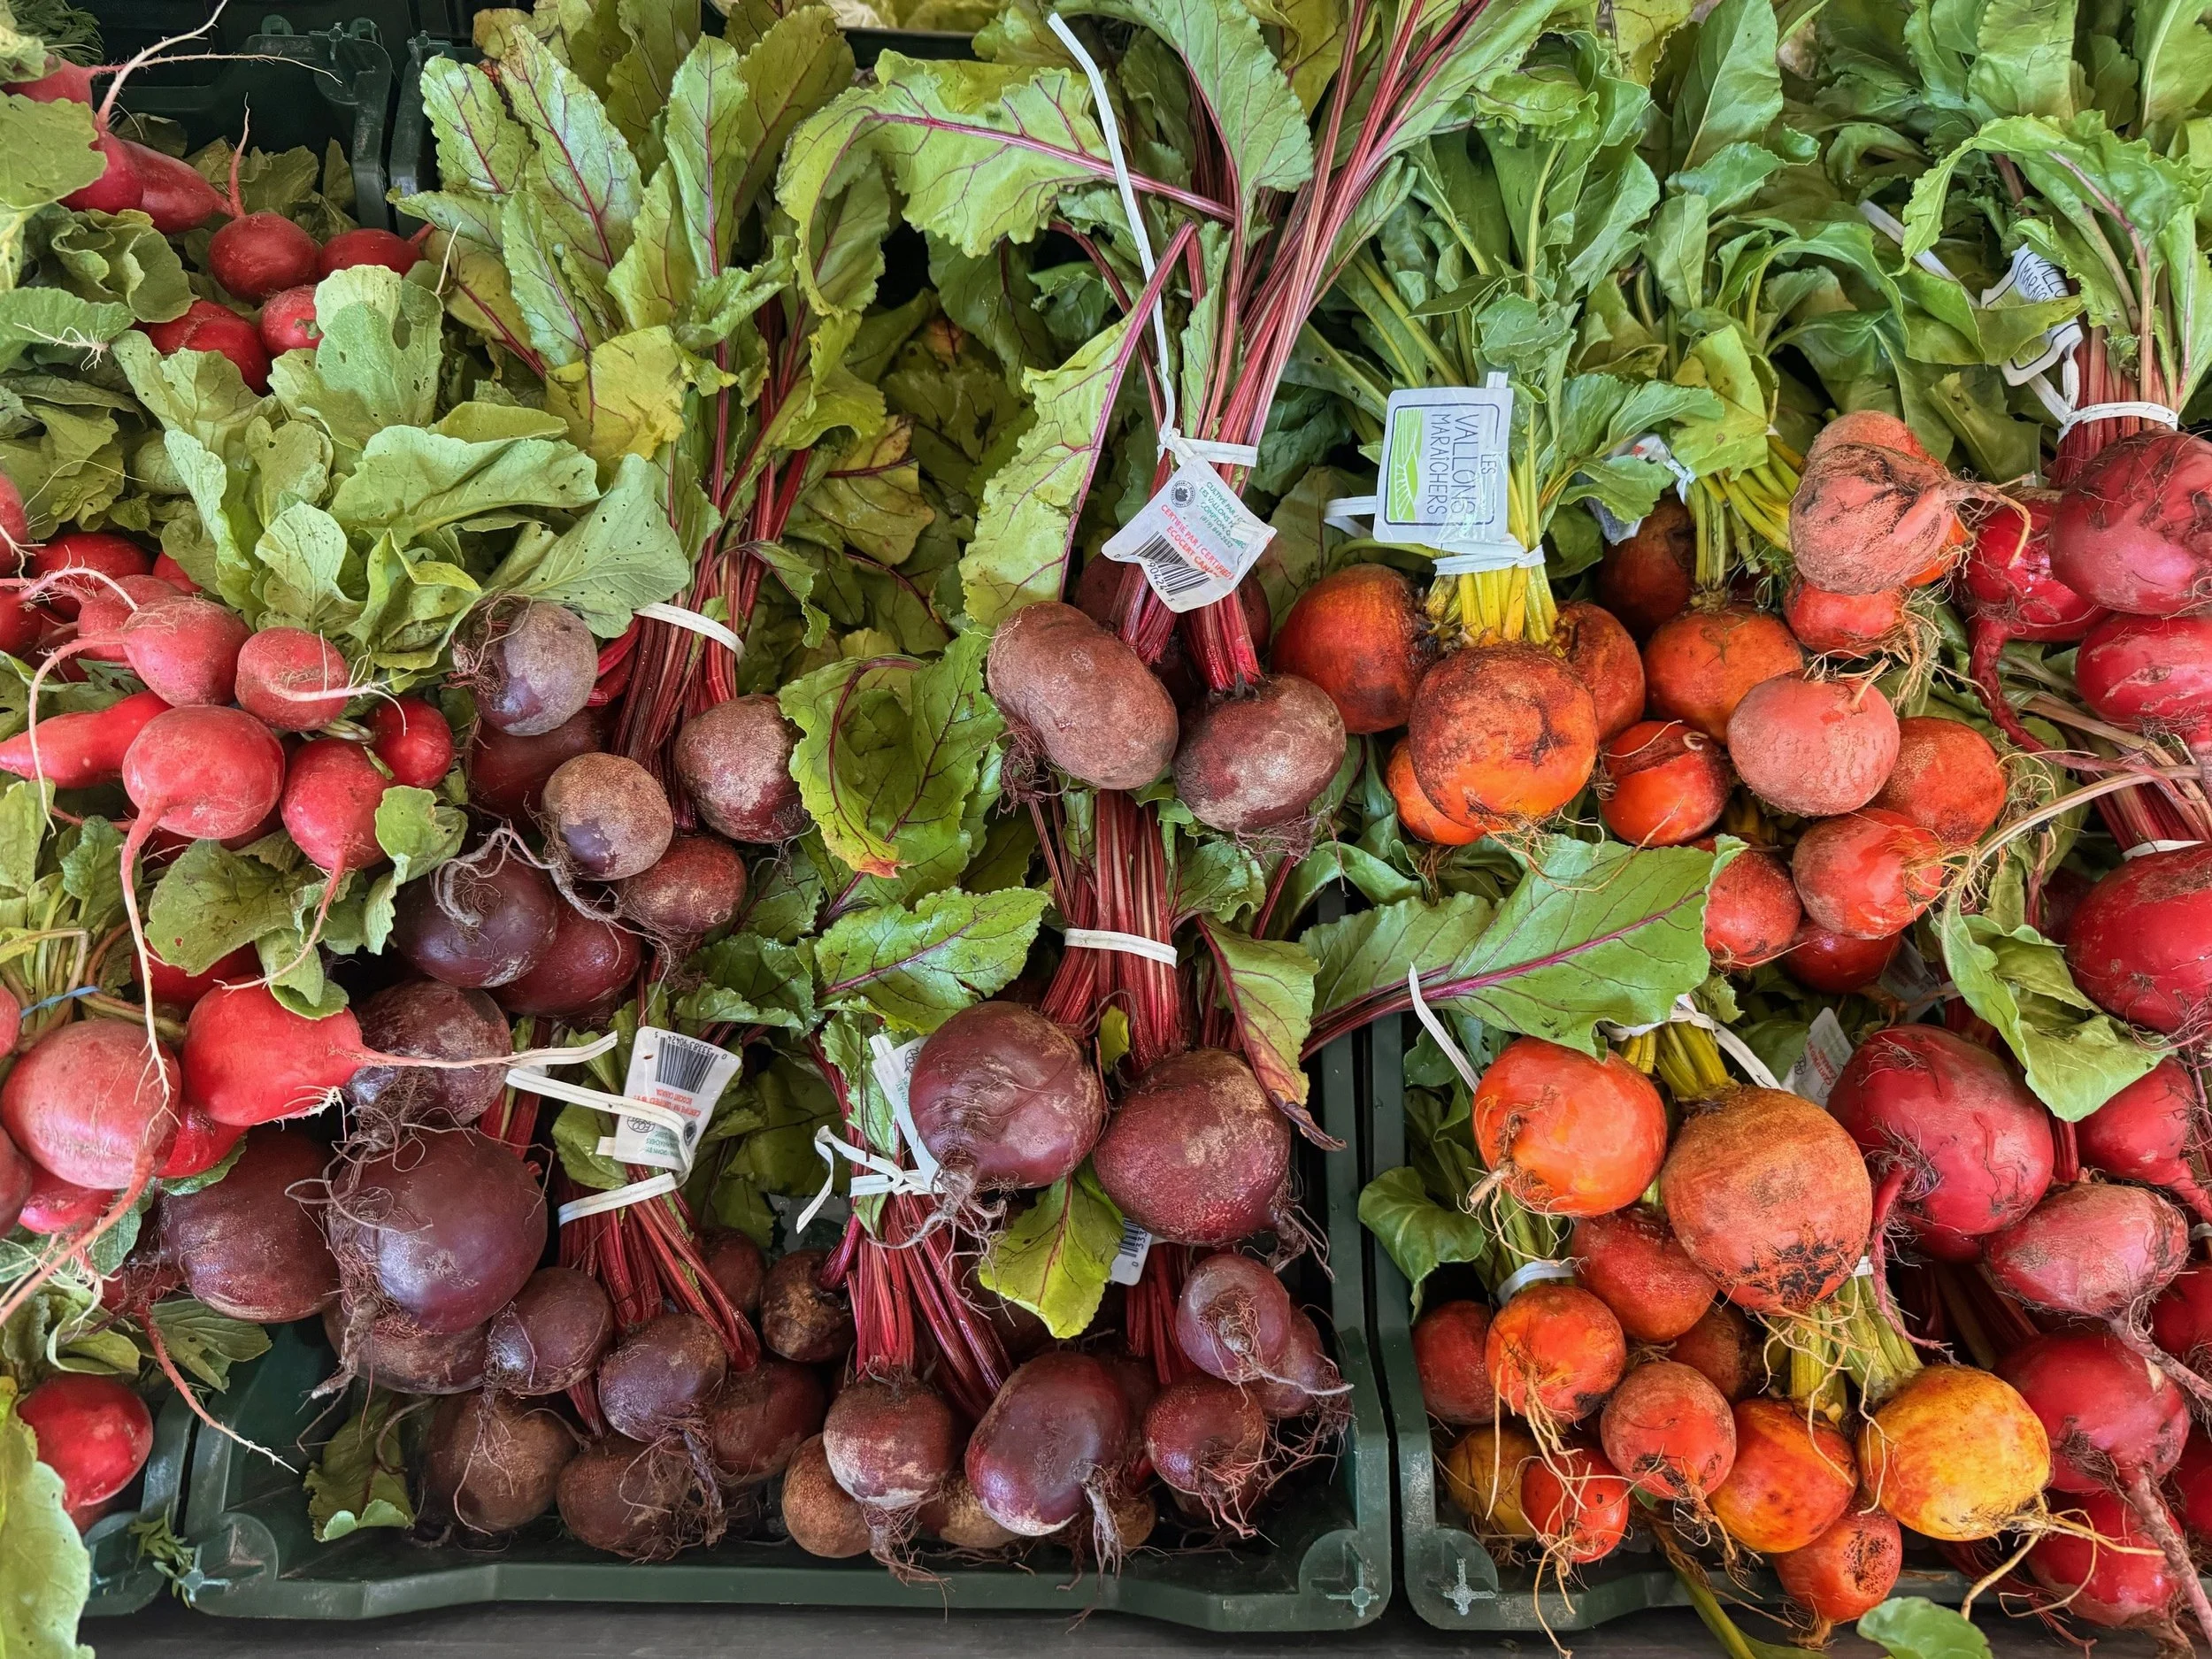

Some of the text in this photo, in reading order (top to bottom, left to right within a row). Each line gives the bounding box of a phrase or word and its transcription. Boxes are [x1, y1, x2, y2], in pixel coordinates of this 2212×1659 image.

[1426, 414, 1452, 515] MARAÎCHERS
[1450, 413, 1479, 515] VALLONS
[1480, 454, 1496, 474] LES
[1199, 487, 1230, 522] LES VALLONS
[1206, 480, 1228, 505] CULTIVÉ
[1225, 503, 1236, 515] PAR
[1160, 503, 1189, 534] CERTIFIÉ
[1185, 531, 1199, 546] PAR
[1199, 547, 1232, 579] CERTIFIED
[1166, 526, 1196, 557] ECOCERT
[1148, 562, 1167, 590] 90424
[667, 1034, 687, 1047] 90424
[689, 1041, 713, 1055] 33383
